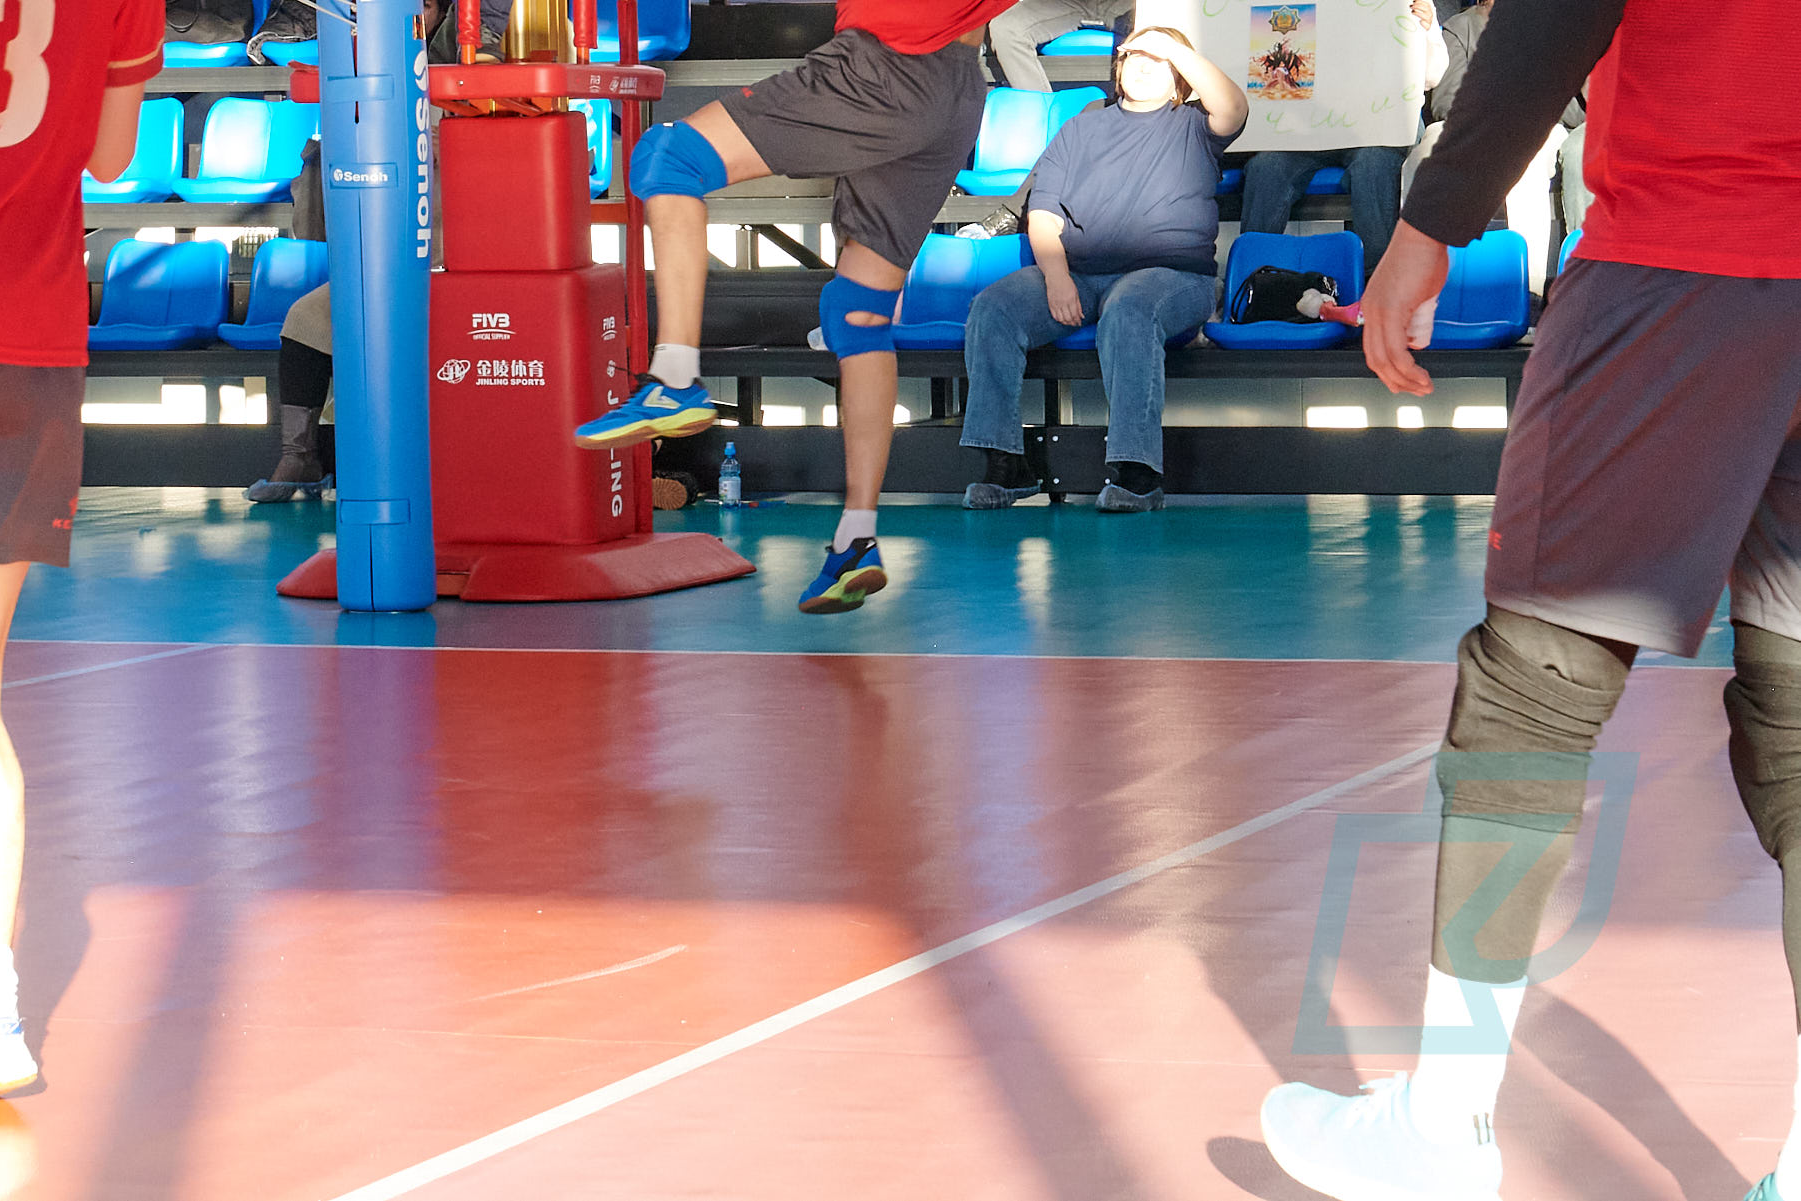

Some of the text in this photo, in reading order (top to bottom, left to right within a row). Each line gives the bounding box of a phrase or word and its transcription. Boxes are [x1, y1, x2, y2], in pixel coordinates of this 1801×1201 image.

[344, 171, 389, 182] Senoh
[416, 98, 431, 258] Senoh
[472, 313, 510, 328] FIVB
[475, 378, 545, 386] JINLING SPORTS
